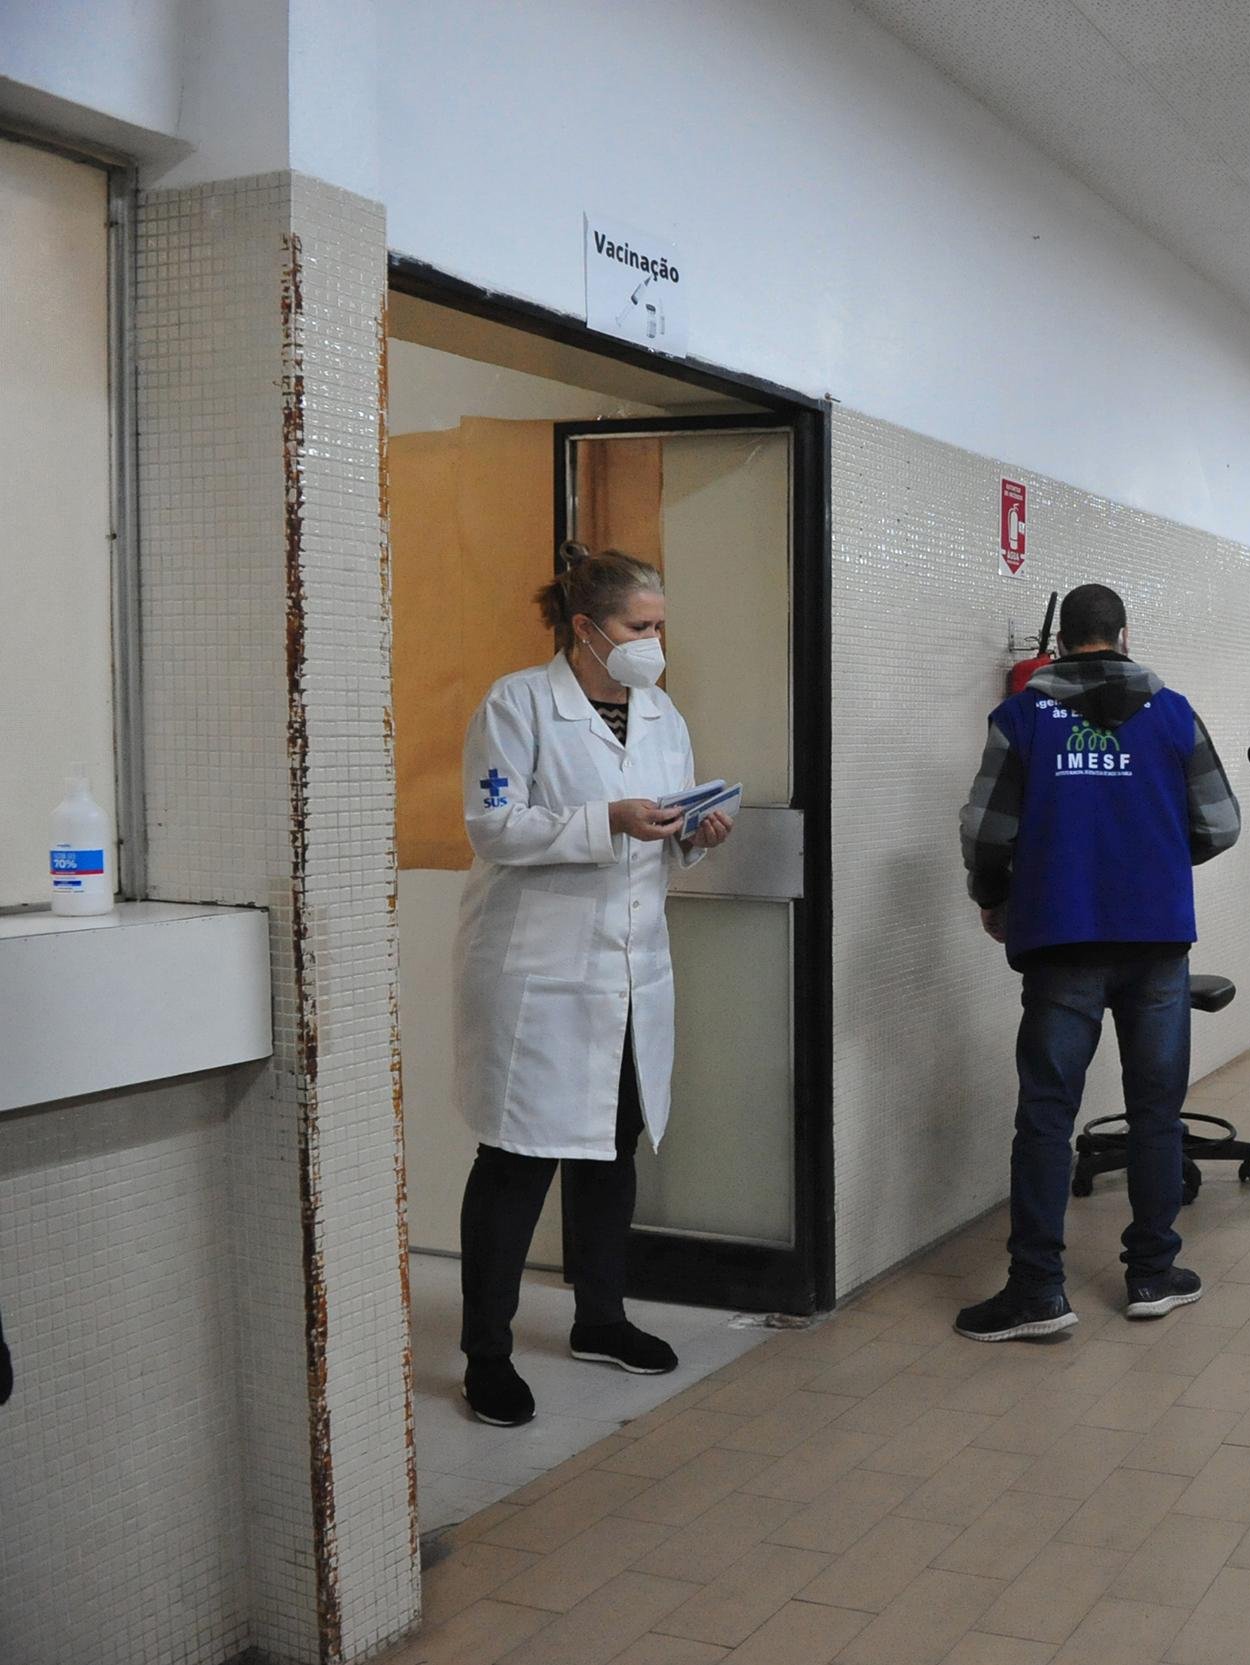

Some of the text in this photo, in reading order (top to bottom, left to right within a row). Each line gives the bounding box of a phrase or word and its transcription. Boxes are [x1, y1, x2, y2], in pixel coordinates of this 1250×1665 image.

[594, 231, 679, 283] Vacinação
[1052, 707, 1068, 719] às
[1057, 753, 1131, 769] IMESF
[483, 796, 508, 809] SUS
[53, 859, 79, 870] 70%
